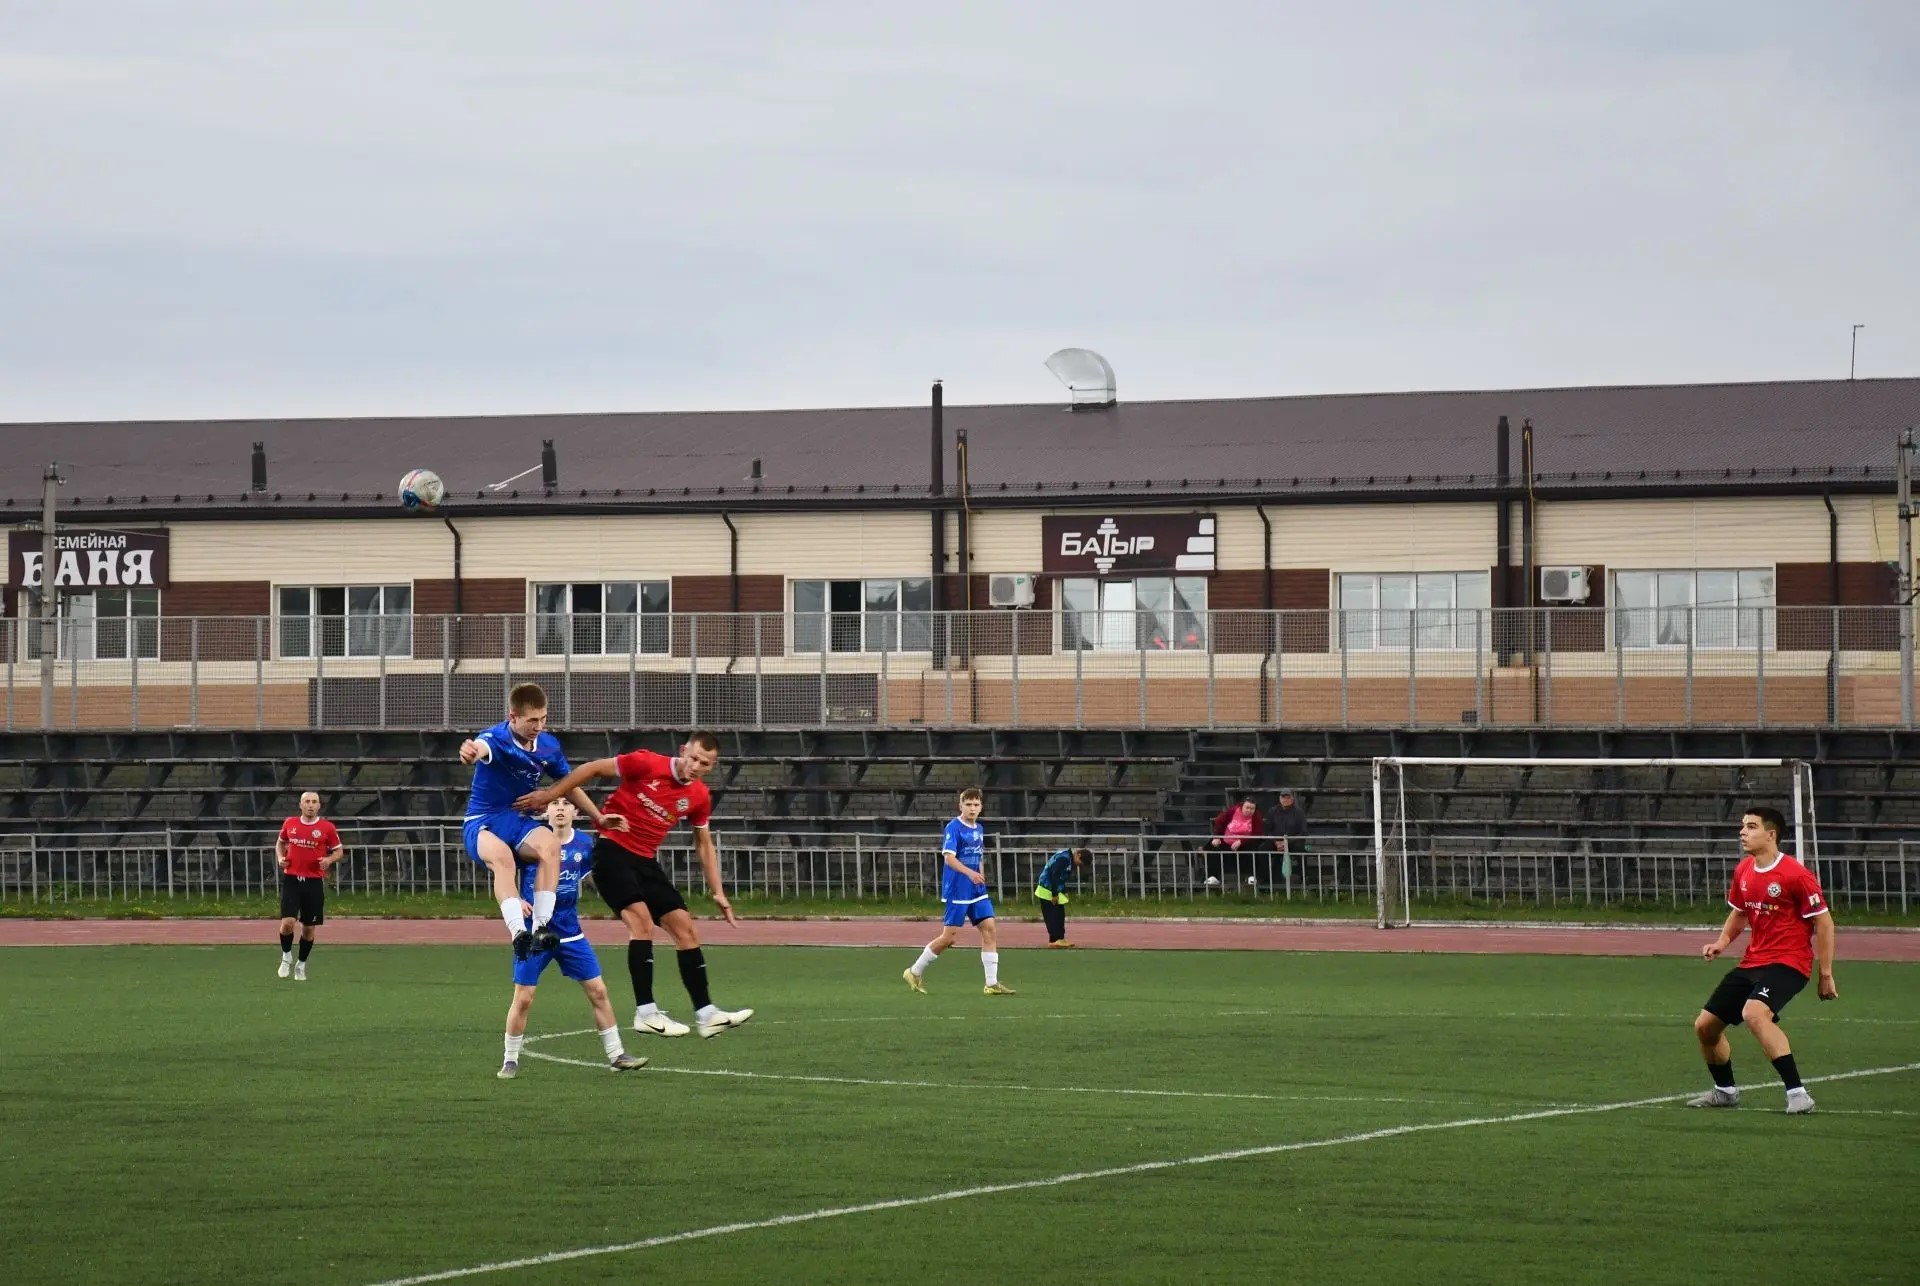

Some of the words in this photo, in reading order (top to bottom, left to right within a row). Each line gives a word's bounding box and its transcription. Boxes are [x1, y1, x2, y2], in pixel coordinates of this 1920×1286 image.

[54, 533, 127, 549] СЕМЕЙНАЯ
[1060, 523, 1155, 561] БАТЫР
[22, 550, 155, 586] БАНЯ
